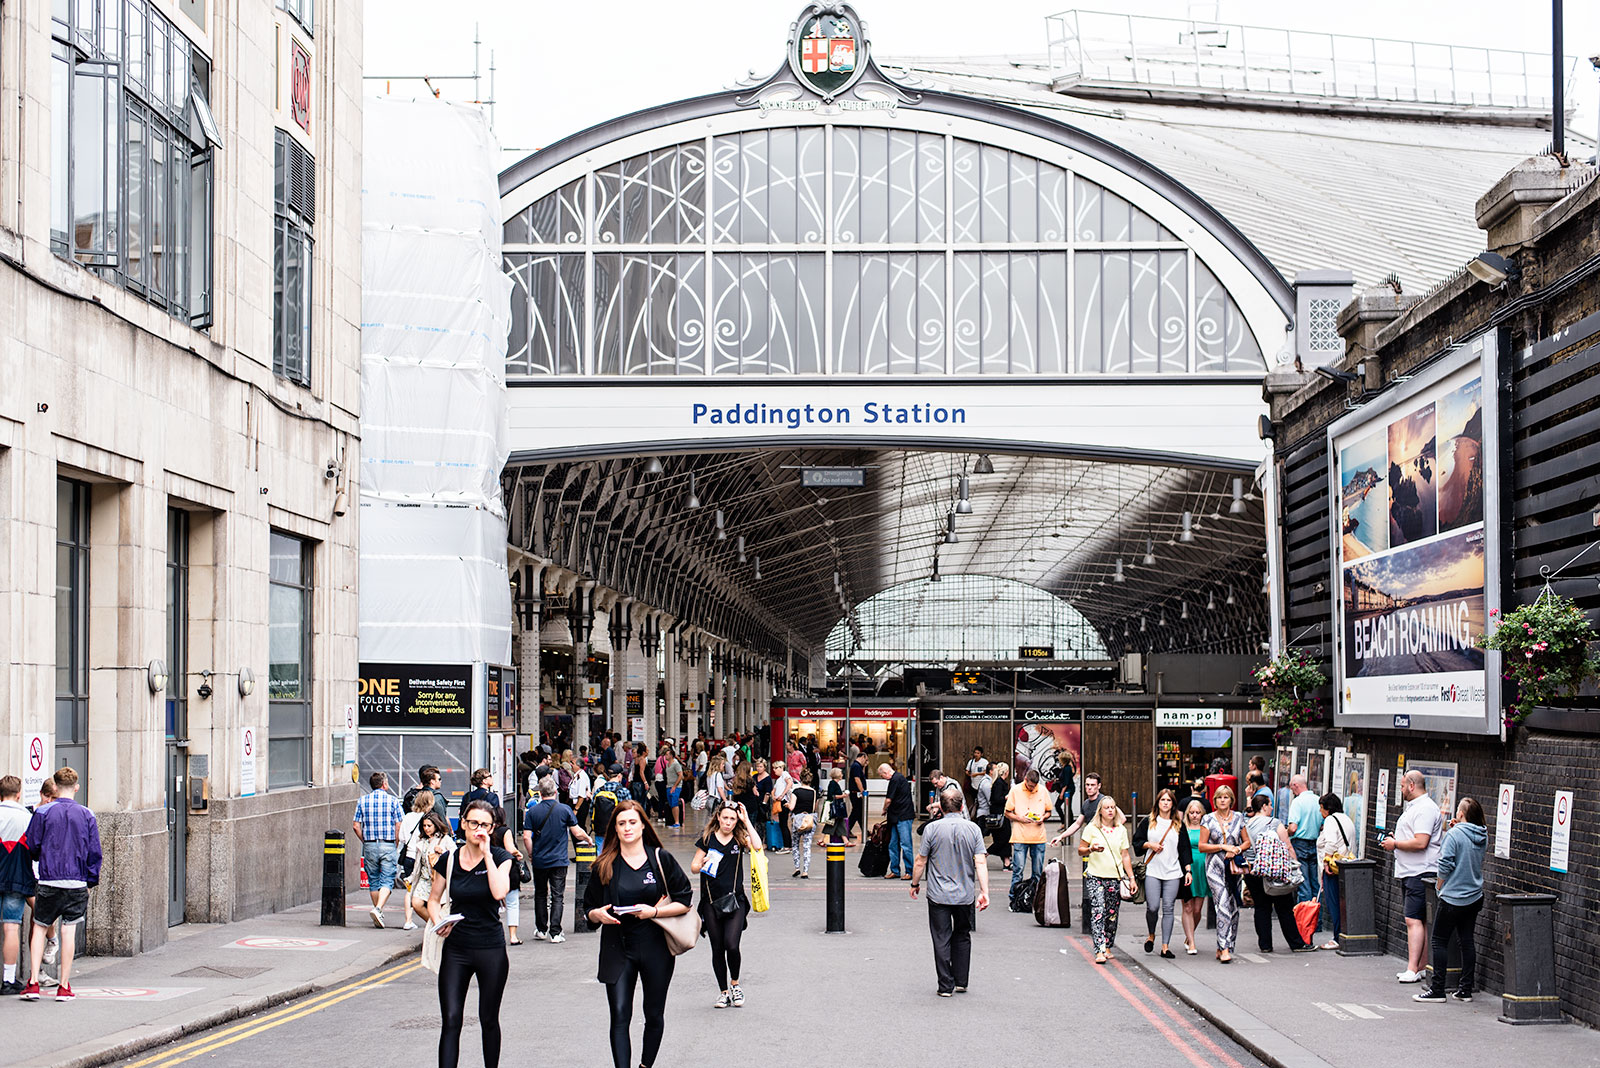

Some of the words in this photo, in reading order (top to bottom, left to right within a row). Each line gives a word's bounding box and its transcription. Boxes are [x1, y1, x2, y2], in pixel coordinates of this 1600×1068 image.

[693, 403, 850, 429] Paddington
[864, 402, 966, 423] Station
[1354, 613, 1397, 660] BEACH
[1399, 600, 1475, 656] ROAMING.
[418, 691, 434, 700] Sorry
[435, 691, 444, 699] for
[362, 705, 401, 713] VICES
[408, 705, 429, 715] during
[865, 709, 892, 718] Paddington
[1163, 711, 1217, 721] nam-po!
